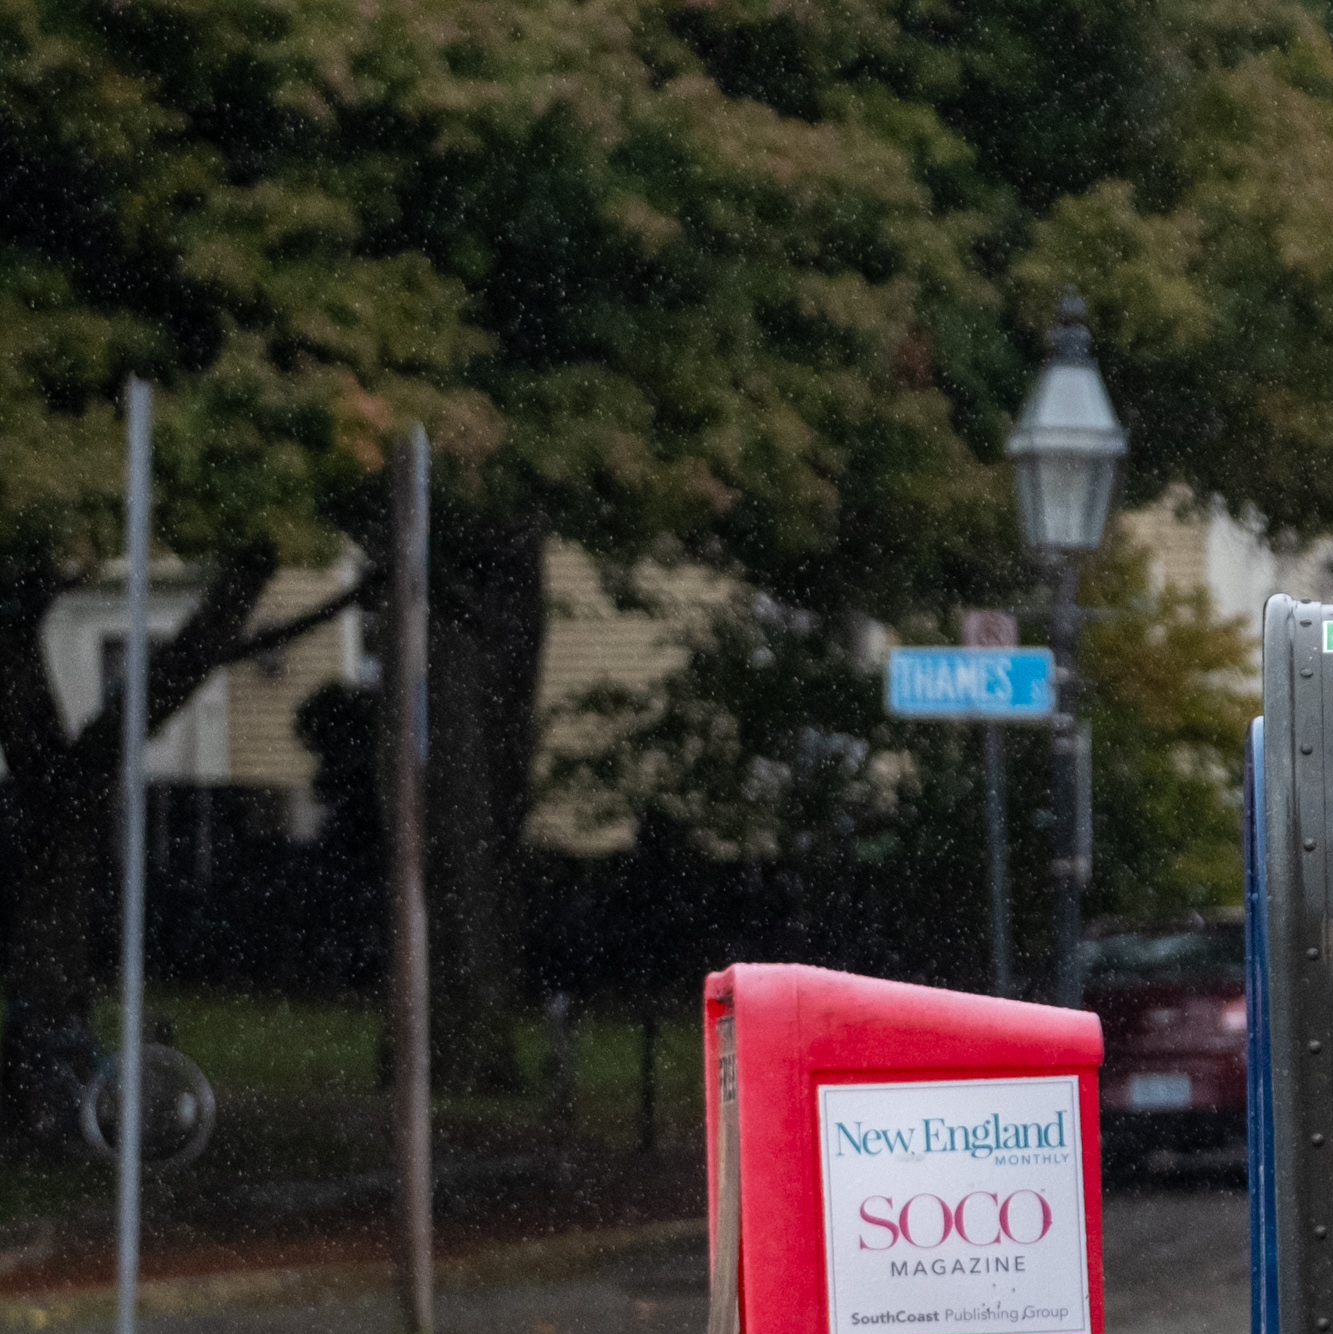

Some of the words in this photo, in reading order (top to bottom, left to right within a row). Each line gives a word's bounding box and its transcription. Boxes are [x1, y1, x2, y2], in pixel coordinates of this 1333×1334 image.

[834, 1120, 916, 1156] New
[922, 1110, 1067, 1159] England
[994, 1152, 1070, 1166] MONTHLY
[859, 1189, 1053, 1251] SOCO
[890, 1255, 1027, 1277] MAGAZINE
[850, 1310, 940, 1326] SouthCoast
[945, 1304, 1019, 1324] Publishing
[1023, 1305, 1069, 1321] Group
